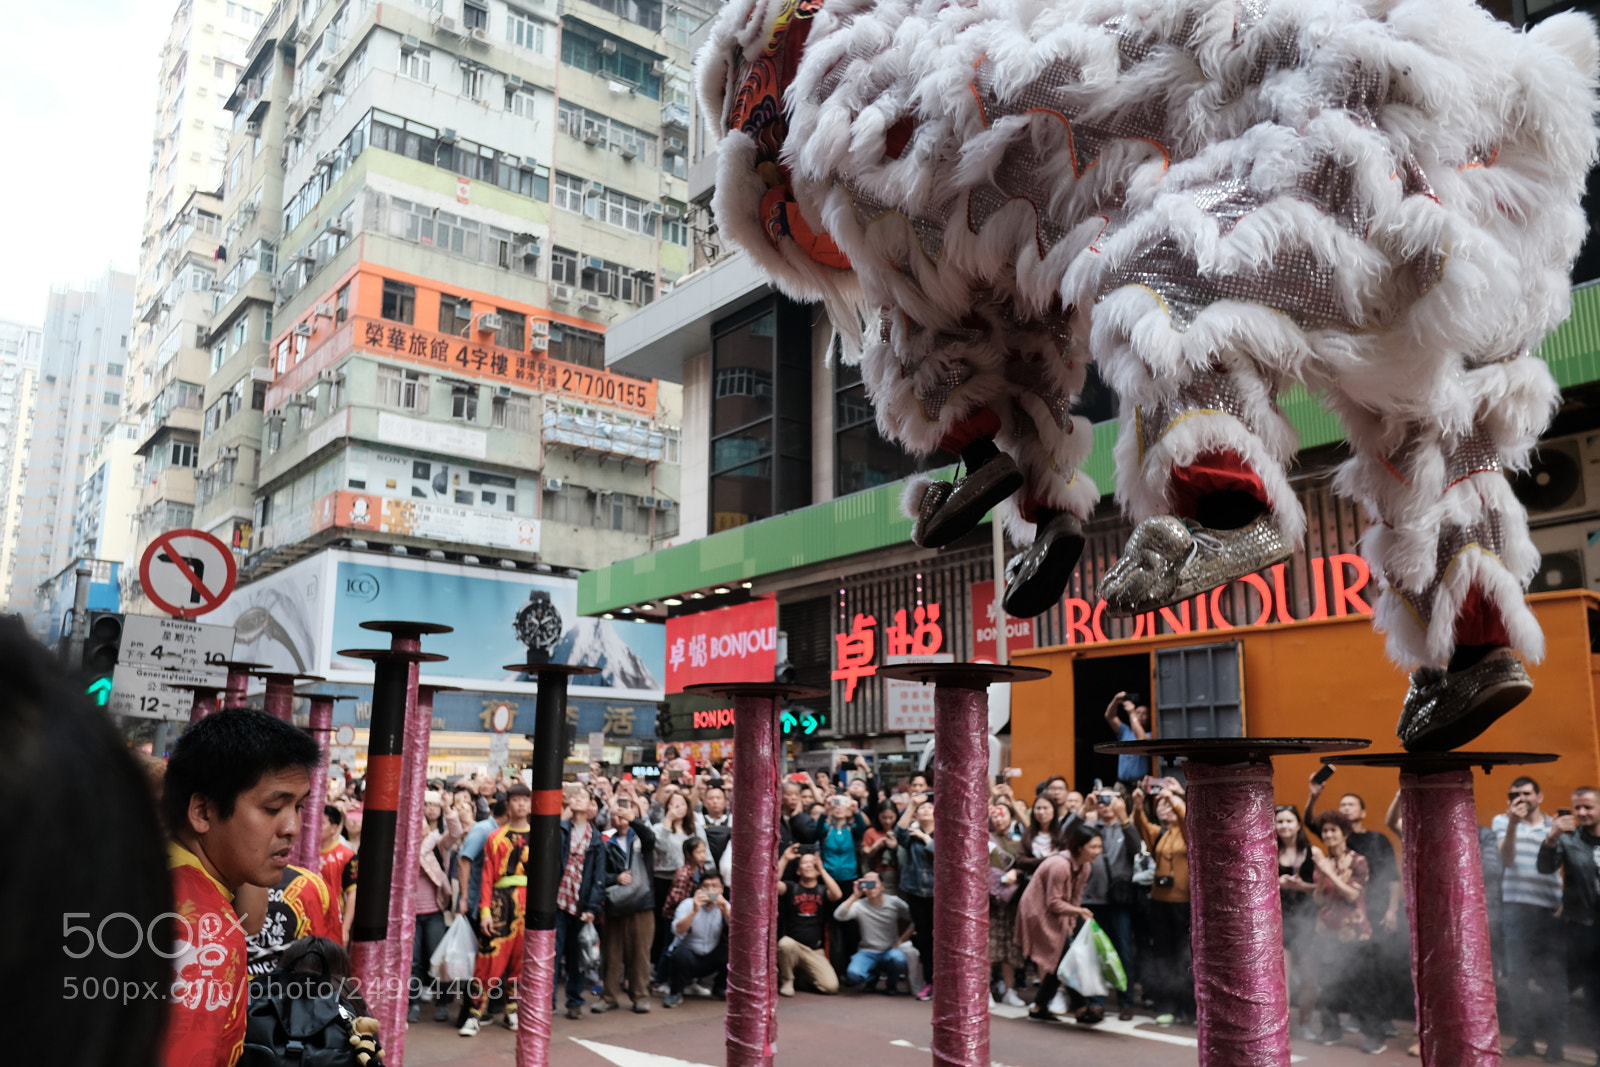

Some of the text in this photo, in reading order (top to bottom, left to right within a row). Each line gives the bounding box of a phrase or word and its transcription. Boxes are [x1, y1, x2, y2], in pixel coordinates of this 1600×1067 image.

[365, 322, 647, 407] 榮華旅館 4字樓 27700155
[160, 620, 202, 632] Saturdays
[976, 622, 1030, 642] BONOUR
[162, 631, 197, 644] 星期六
[710, 627, 777, 660] BONJOU
[130, 641, 144, 649] pm
[150, 645, 163, 660] 4
[183, 647, 197, 655] pm
[137, 670, 208, 684] General Holidays
[140, 695, 160, 713] 12
